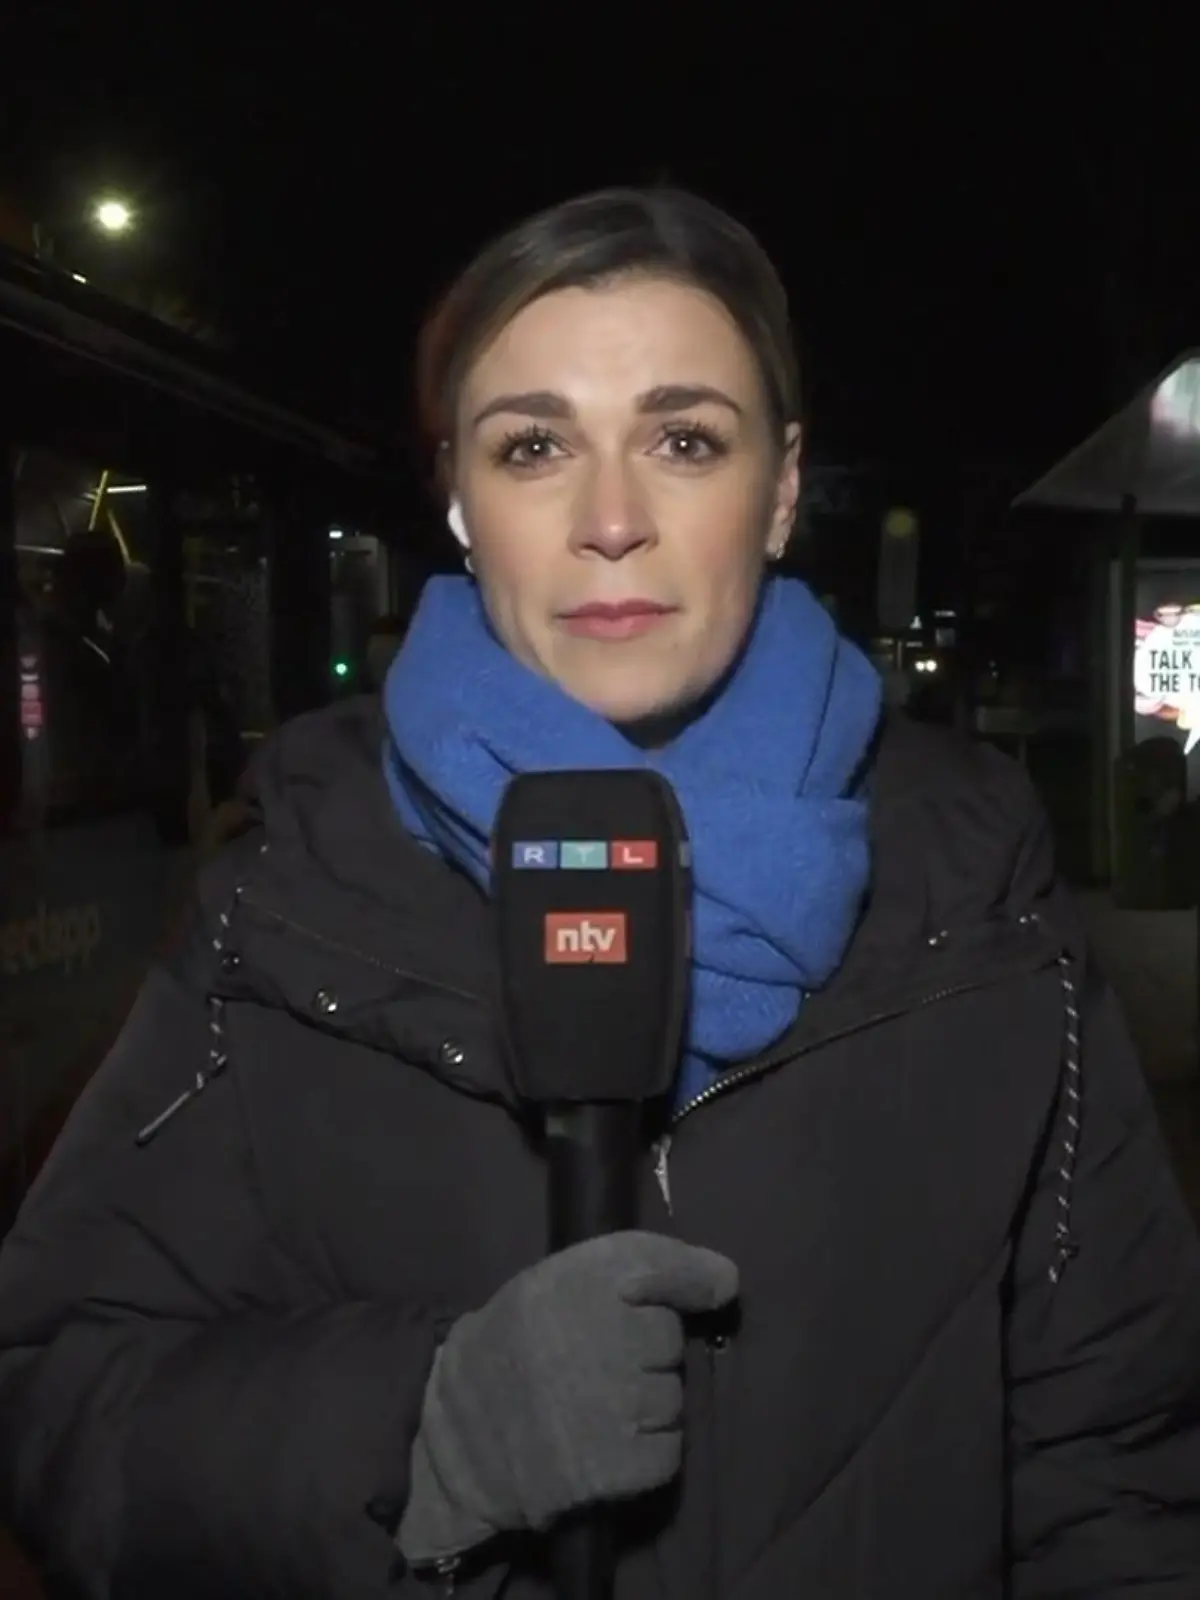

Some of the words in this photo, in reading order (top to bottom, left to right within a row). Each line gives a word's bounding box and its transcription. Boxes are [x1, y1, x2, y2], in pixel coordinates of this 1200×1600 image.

[1149, 649, 1192, 669] TALK
[1149, 673, 1180, 692] THE
[1188, 673, 1200, 692] T
[522, 844, 644, 865] RTL
[556, 920, 616, 952] ntv
